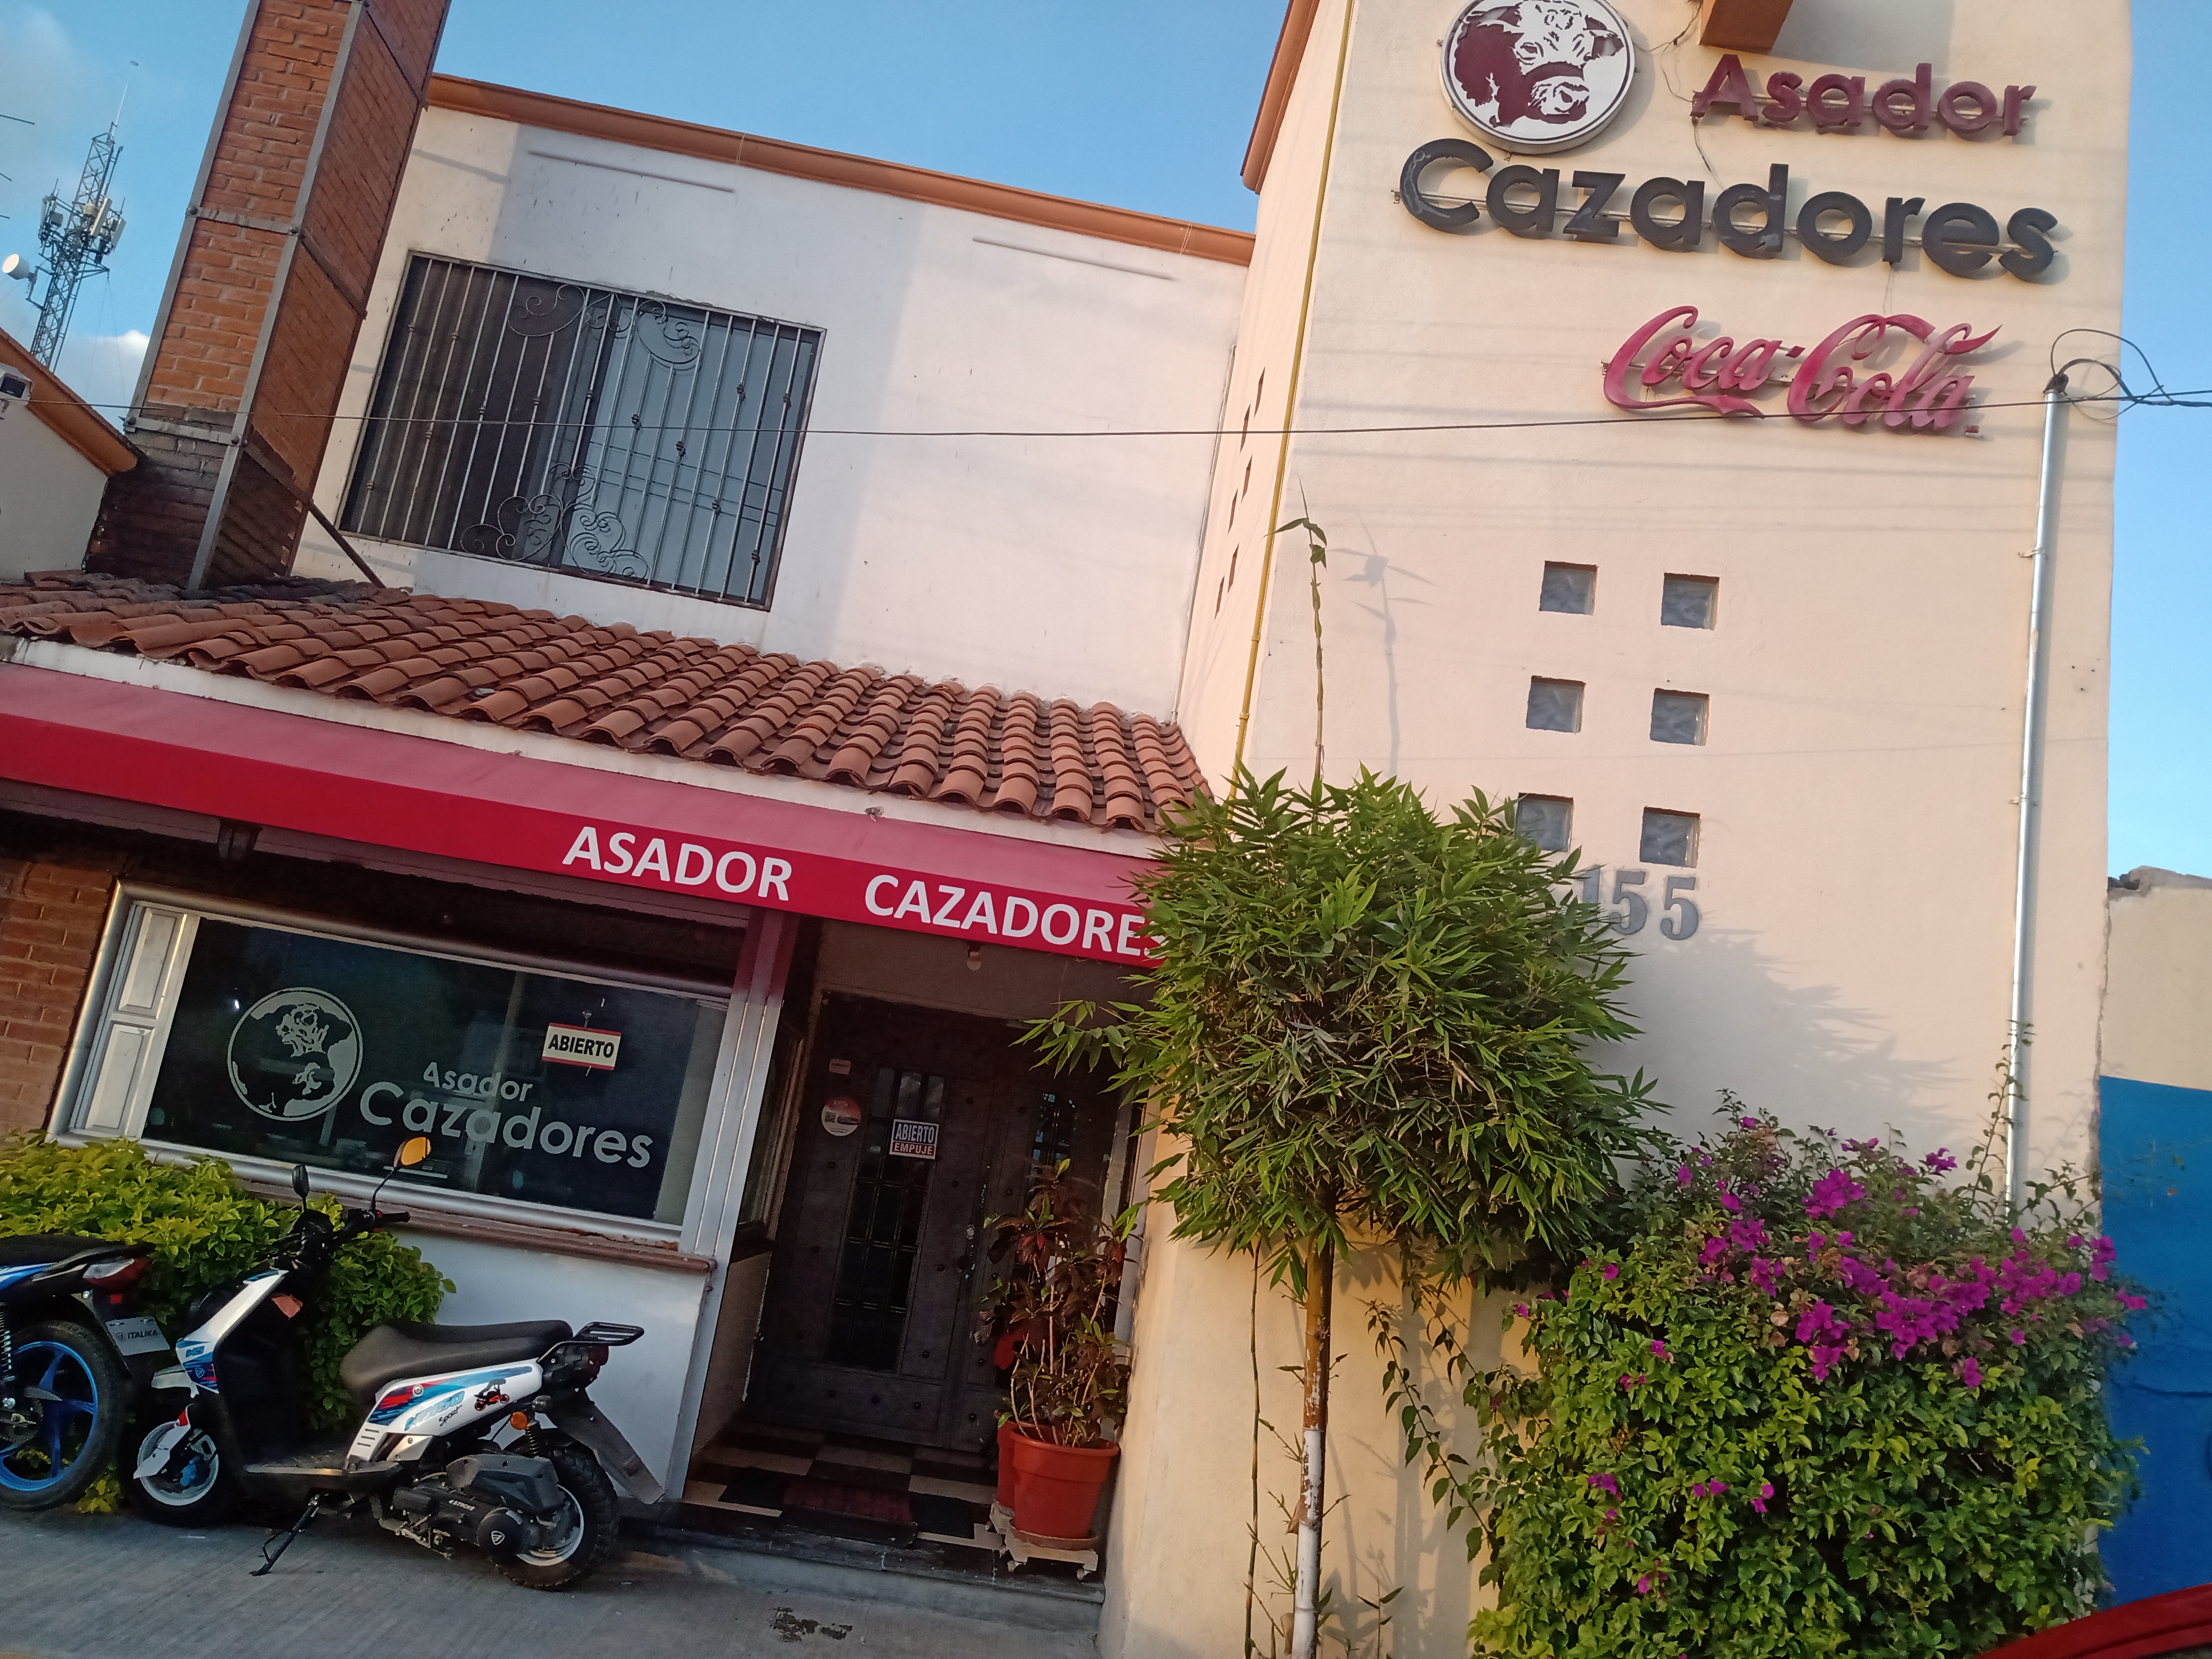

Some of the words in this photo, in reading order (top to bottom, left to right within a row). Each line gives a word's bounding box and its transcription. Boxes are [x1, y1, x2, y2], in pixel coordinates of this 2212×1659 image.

[1691, 54, 2037, 139] Asador
[1400, 138, 2060, 276] Cazadores
[1603, 305, 2002, 427] Coca-Cola
[562, 826, 793, 902] ASADOR
[1581, 864, 1699, 940] 155
[423, 1061, 533, 1102] Asador
[548, 1034, 615, 1058] ABIERTO
[359, 1081, 654, 1168] Cazadores
[894, 1142, 933, 1155] EMPUJE
[895, 1123, 935, 1144] ABIERTO
[128, 1330, 158, 1339] ITALIKA
